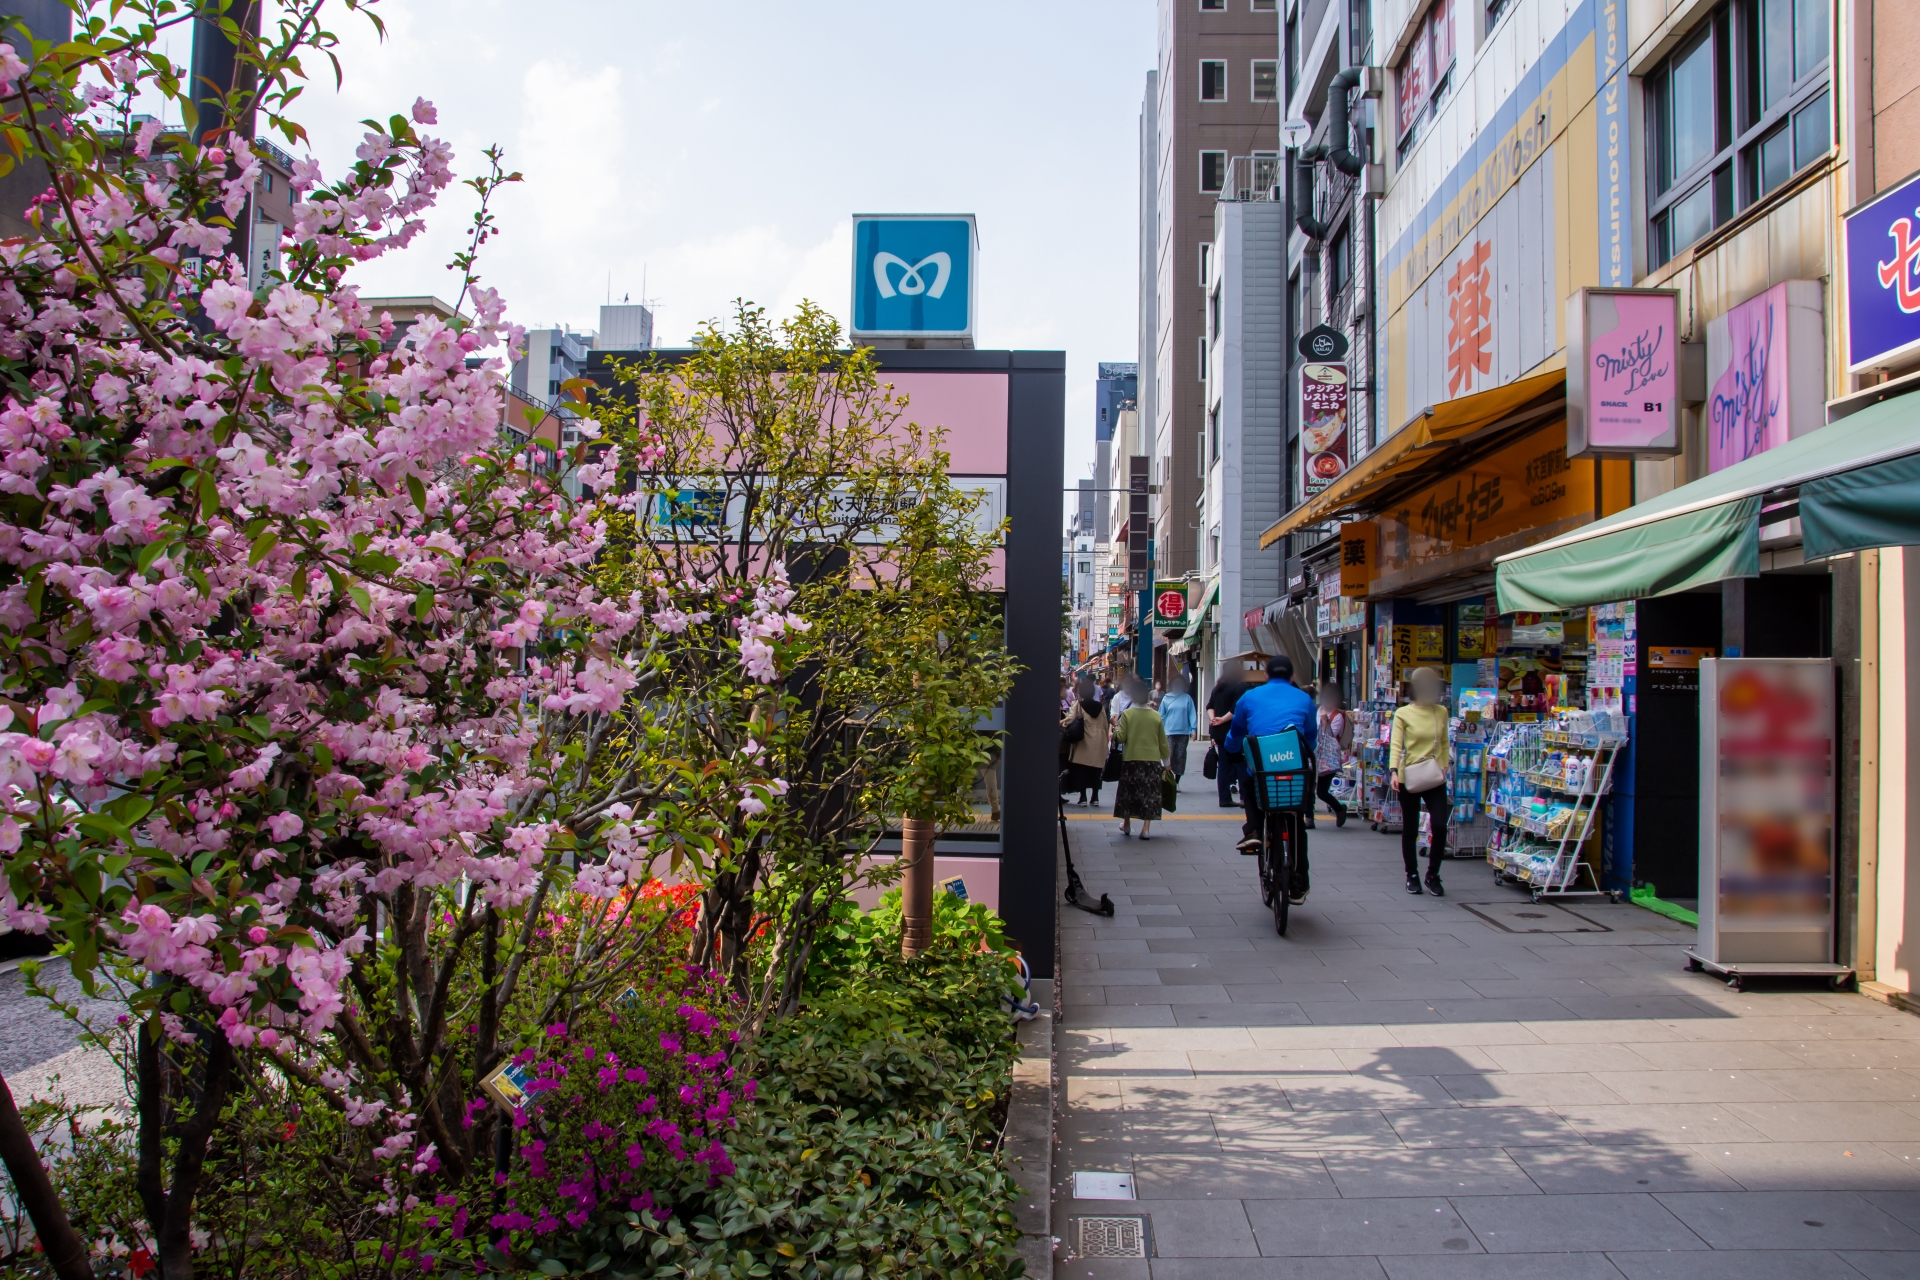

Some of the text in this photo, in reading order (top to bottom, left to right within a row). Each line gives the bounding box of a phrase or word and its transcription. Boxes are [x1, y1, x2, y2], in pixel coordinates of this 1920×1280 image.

[1406, 187, 1482, 293] Matsumoto
[1447, 238, 1492, 400] 薬
[1596, 325, 1662, 382] Misty
[1306, 384, 1344, 393] アジアン
[1624, 361, 1669, 395] Love
[1303, 393, 1347, 401] レストラン
[1311, 402, 1340, 410] モニカ
[1643, 402, 1662, 412] B1
[1344, 539, 1365, 566] 薬
[1159, 593, 1183, 616] 得
[1270, 751, 1294, 762] Wolt
